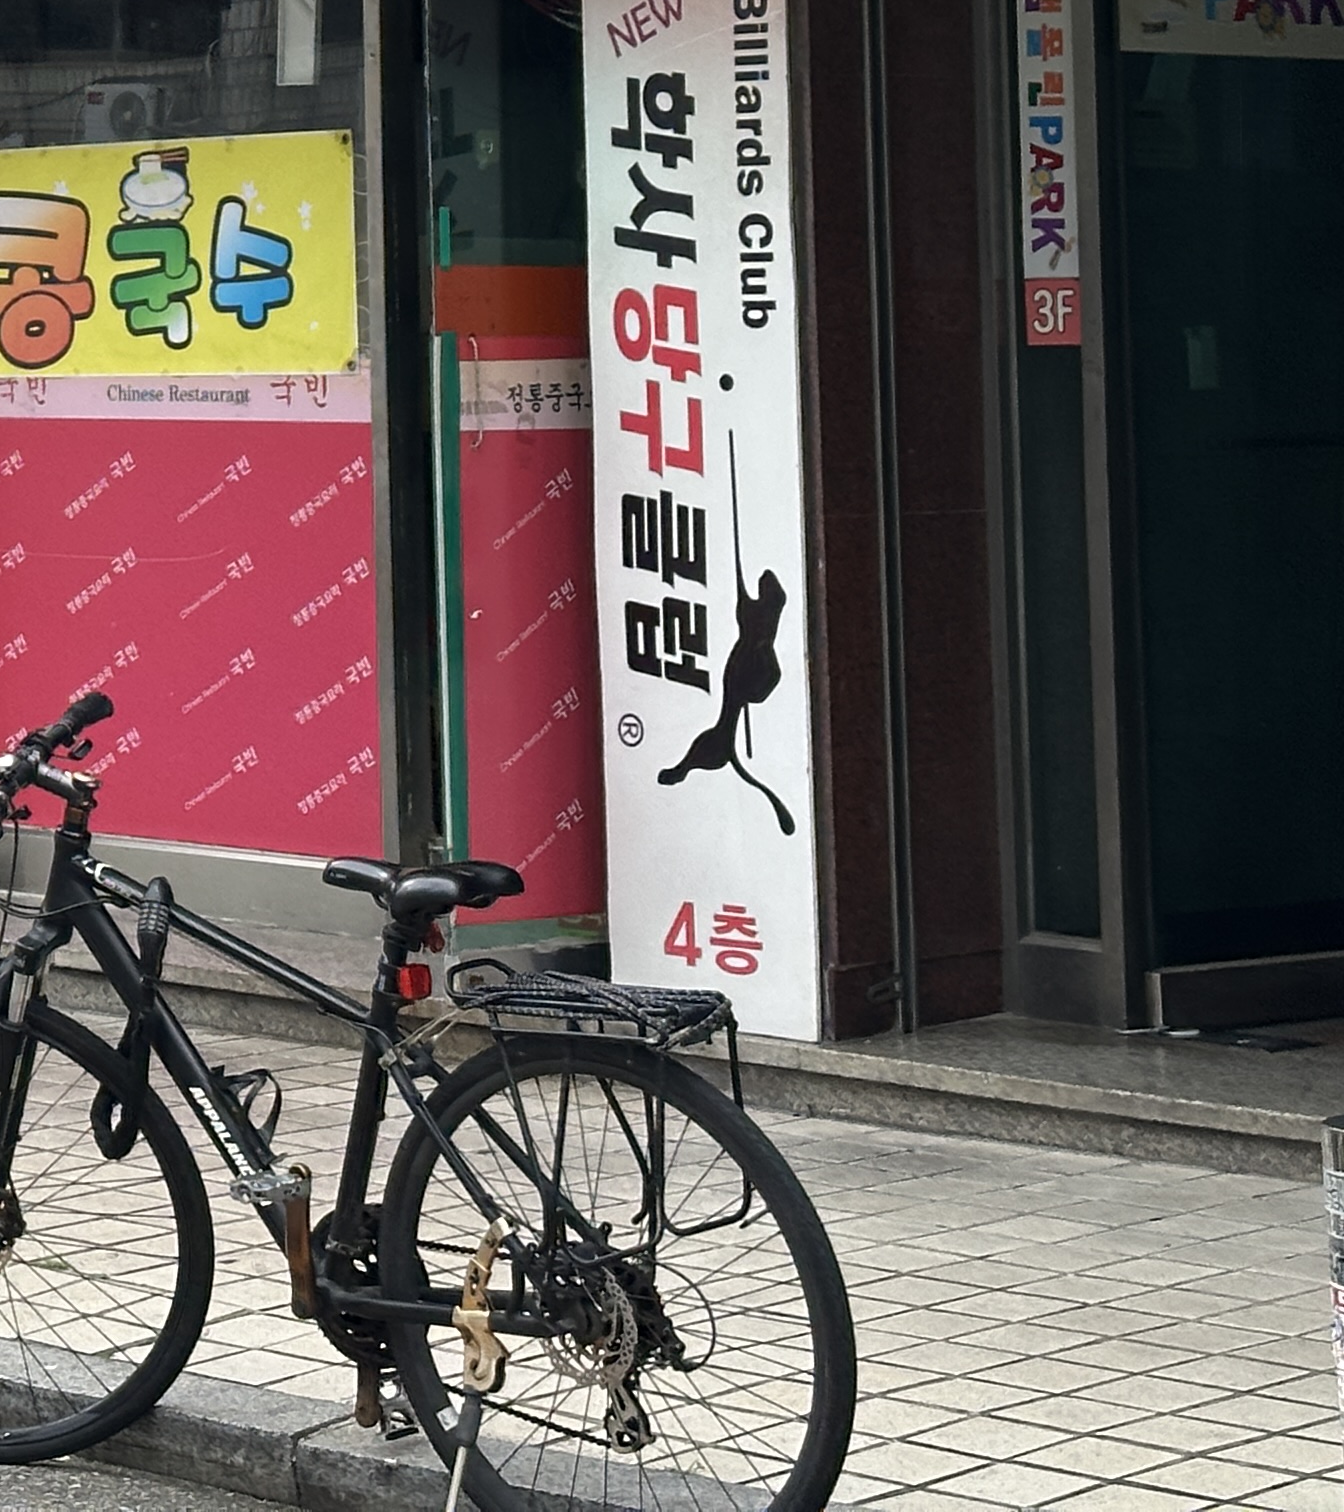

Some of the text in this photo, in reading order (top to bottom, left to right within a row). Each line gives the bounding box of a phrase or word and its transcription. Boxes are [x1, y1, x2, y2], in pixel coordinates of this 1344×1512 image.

[1028, 115, 1068, 255] PARK
[738, 212, 778, 330] Club
[1032, 288, 1075, 334] 3F
[106, 383, 164, 404] Chinese
[168, 384, 251, 405] Restaurant
[506, 382, 592, 414] 정통중국
[663, 900, 764, 977] 4층
